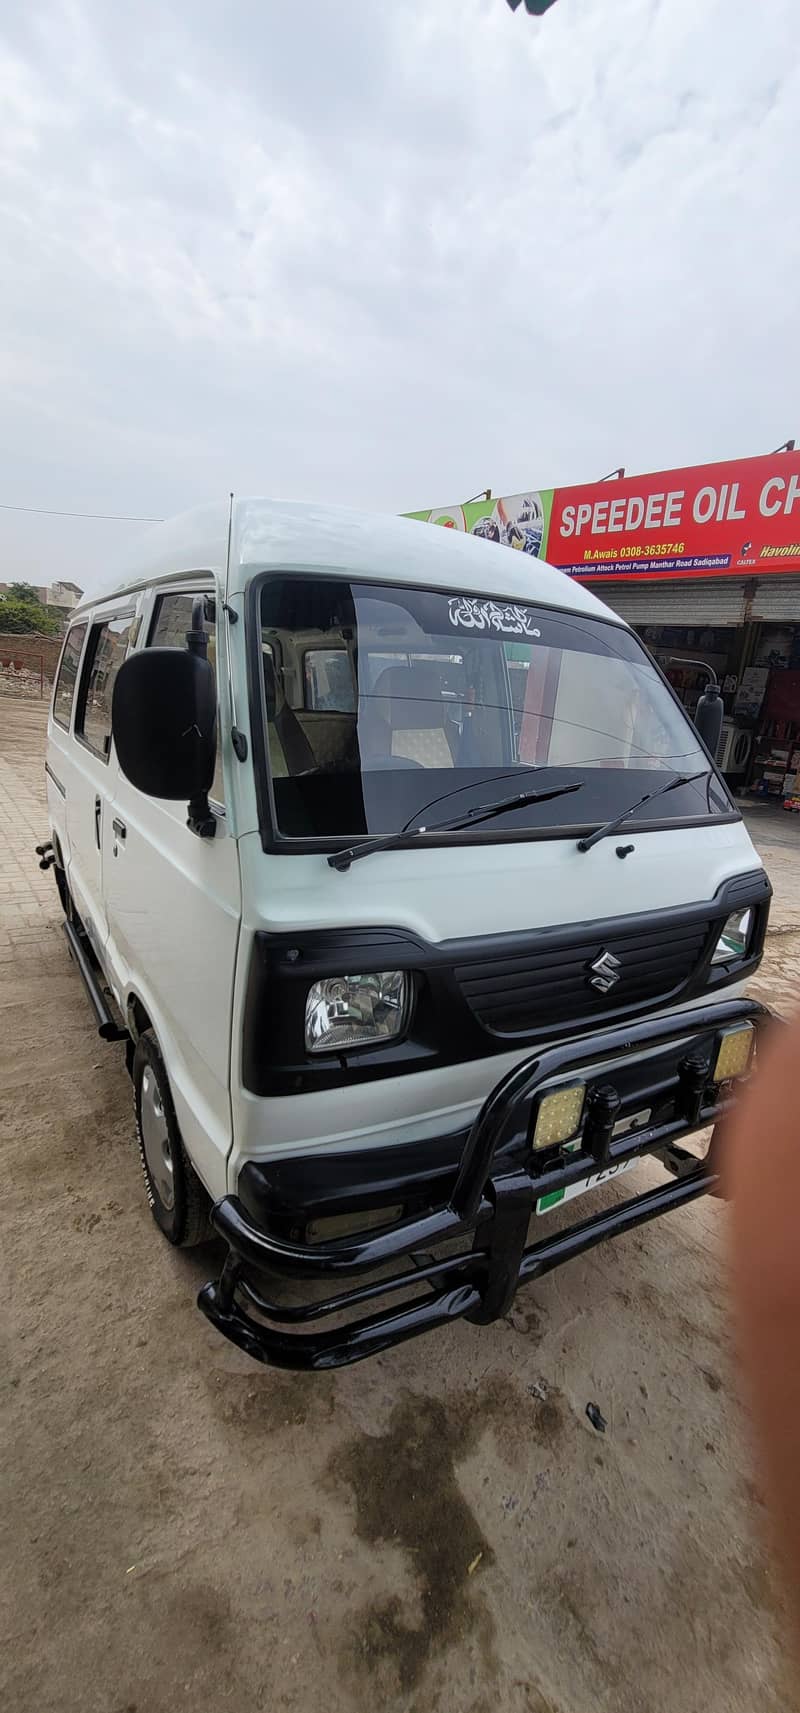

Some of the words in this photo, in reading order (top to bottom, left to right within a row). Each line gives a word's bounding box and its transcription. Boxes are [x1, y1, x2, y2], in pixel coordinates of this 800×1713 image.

[560, 490, 685, 537] SPEEDEE
[692, 483, 746, 524] OIL
[583, 548, 618, 560] M.Awais
[620, 542, 685, 557] 0308-3635746
[597, 564, 614, 572] Attock
[615, 562, 631, 571] Petrol
[633, 562, 649, 571] Pump
[650, 560, 675, 569] Manthar
[676, 559, 692, 567] Road
[693, 557, 729, 567] Sadiqabad
